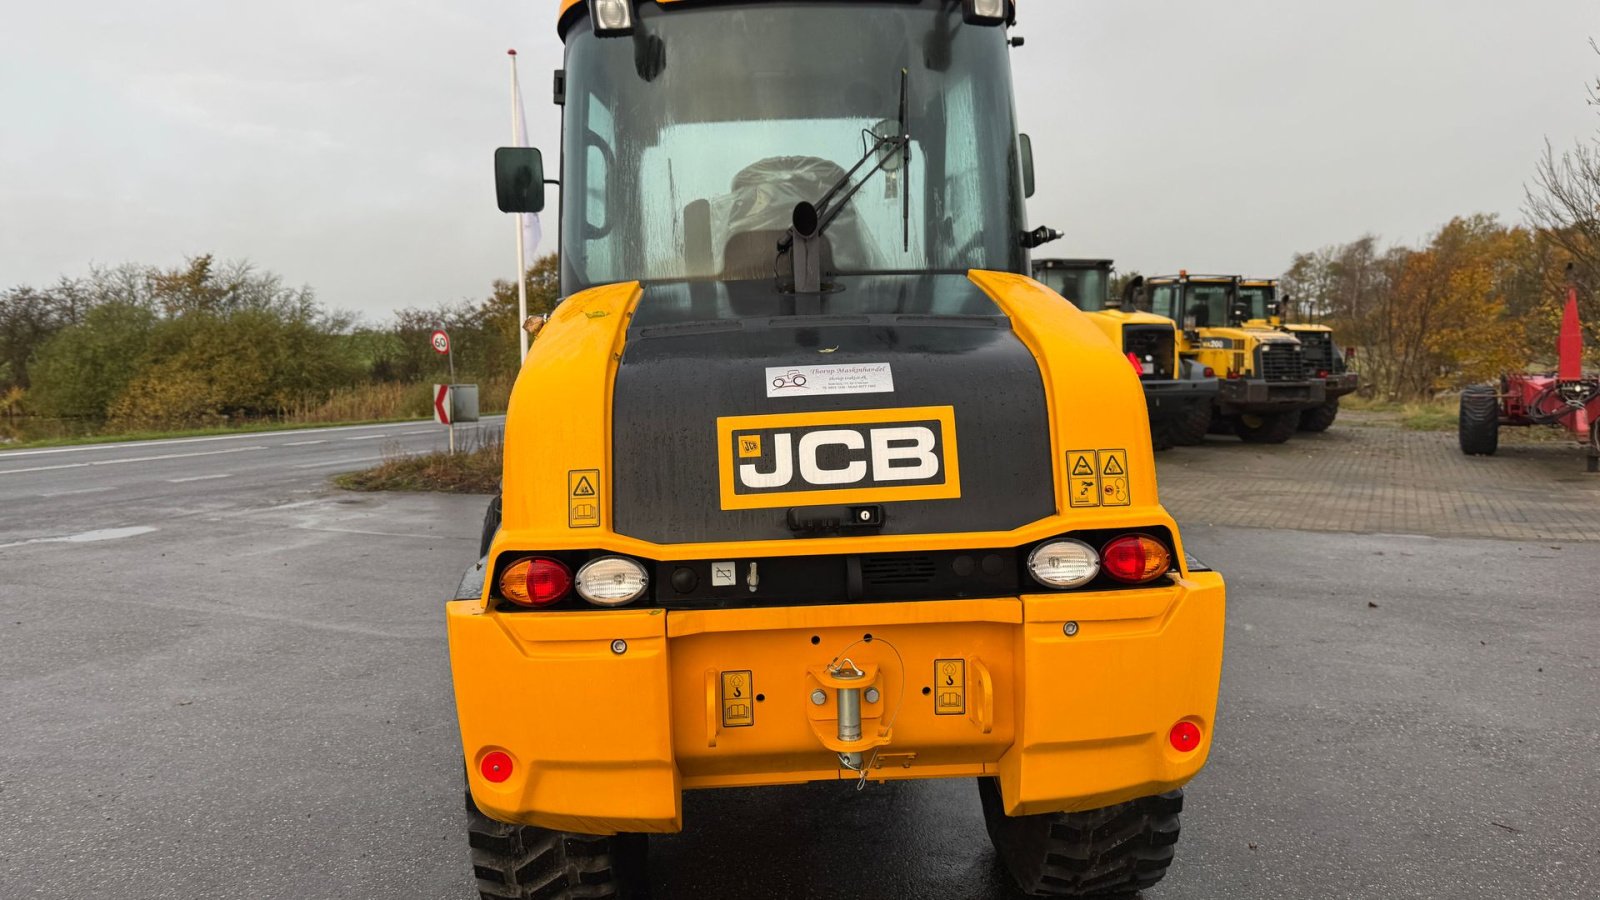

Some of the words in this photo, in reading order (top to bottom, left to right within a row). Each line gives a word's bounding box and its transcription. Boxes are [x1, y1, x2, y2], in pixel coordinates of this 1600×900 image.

[435, 338, 446, 347] 60
[743, 440, 758, 452] JCB
[739, 426, 939, 488] JCB
